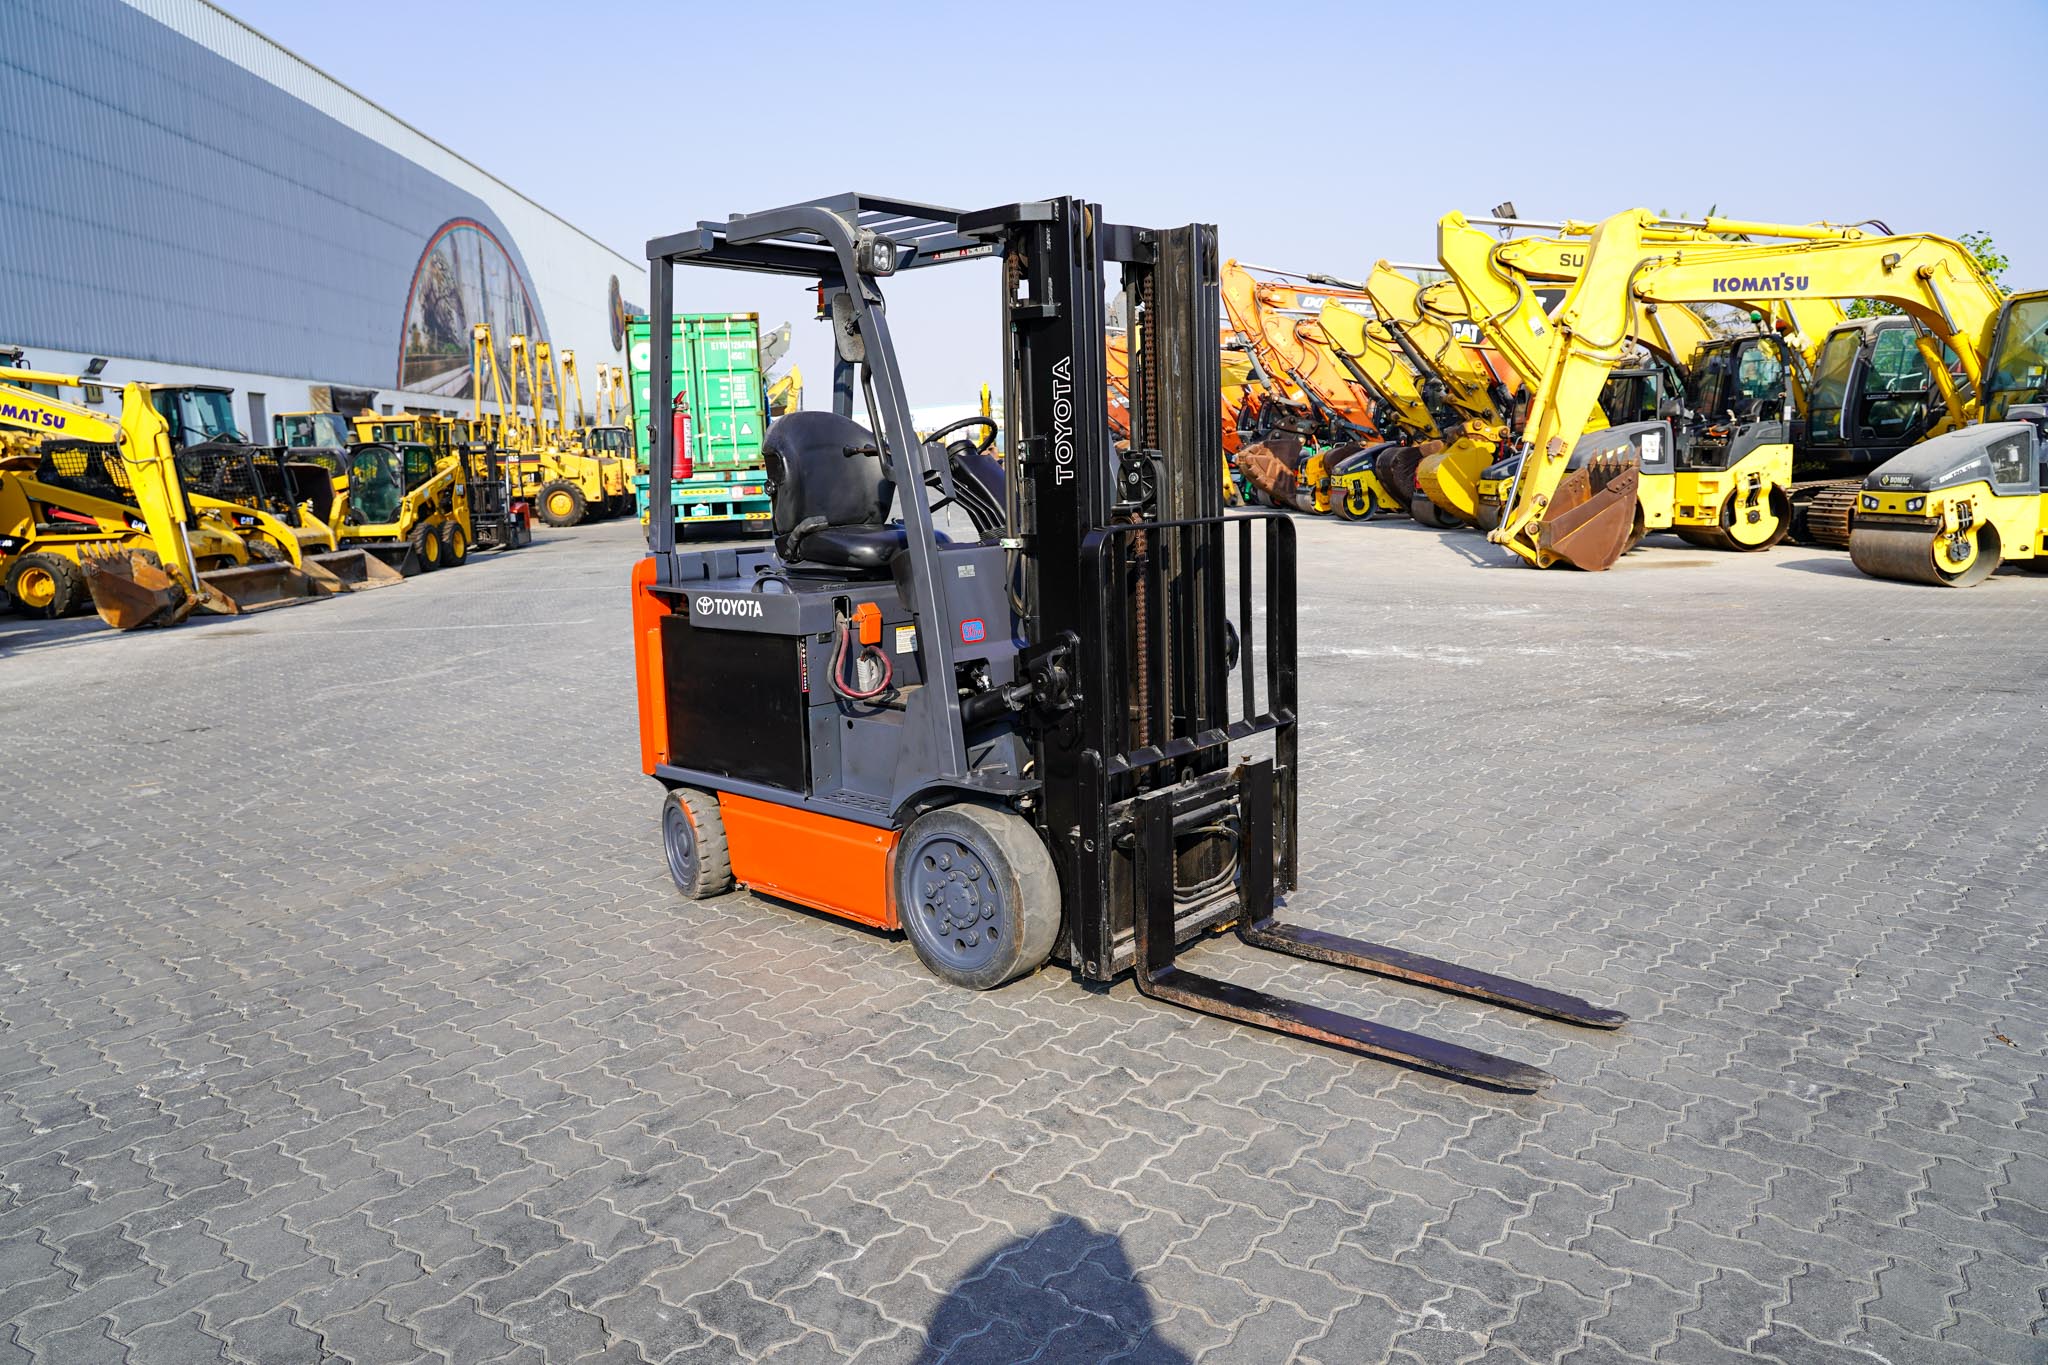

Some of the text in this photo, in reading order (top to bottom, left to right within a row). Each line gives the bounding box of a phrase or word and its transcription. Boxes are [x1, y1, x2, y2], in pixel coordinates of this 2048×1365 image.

[1713, 272, 1809, 293] KOMATSU
[1452, 323, 1480, 343] CAT
[0, 404, 66, 429] MATSU
[1052, 355, 1075, 485] TOYOTA
[240, 516, 255, 526] CAT
[714, 598, 764, 618] TOYOTA
